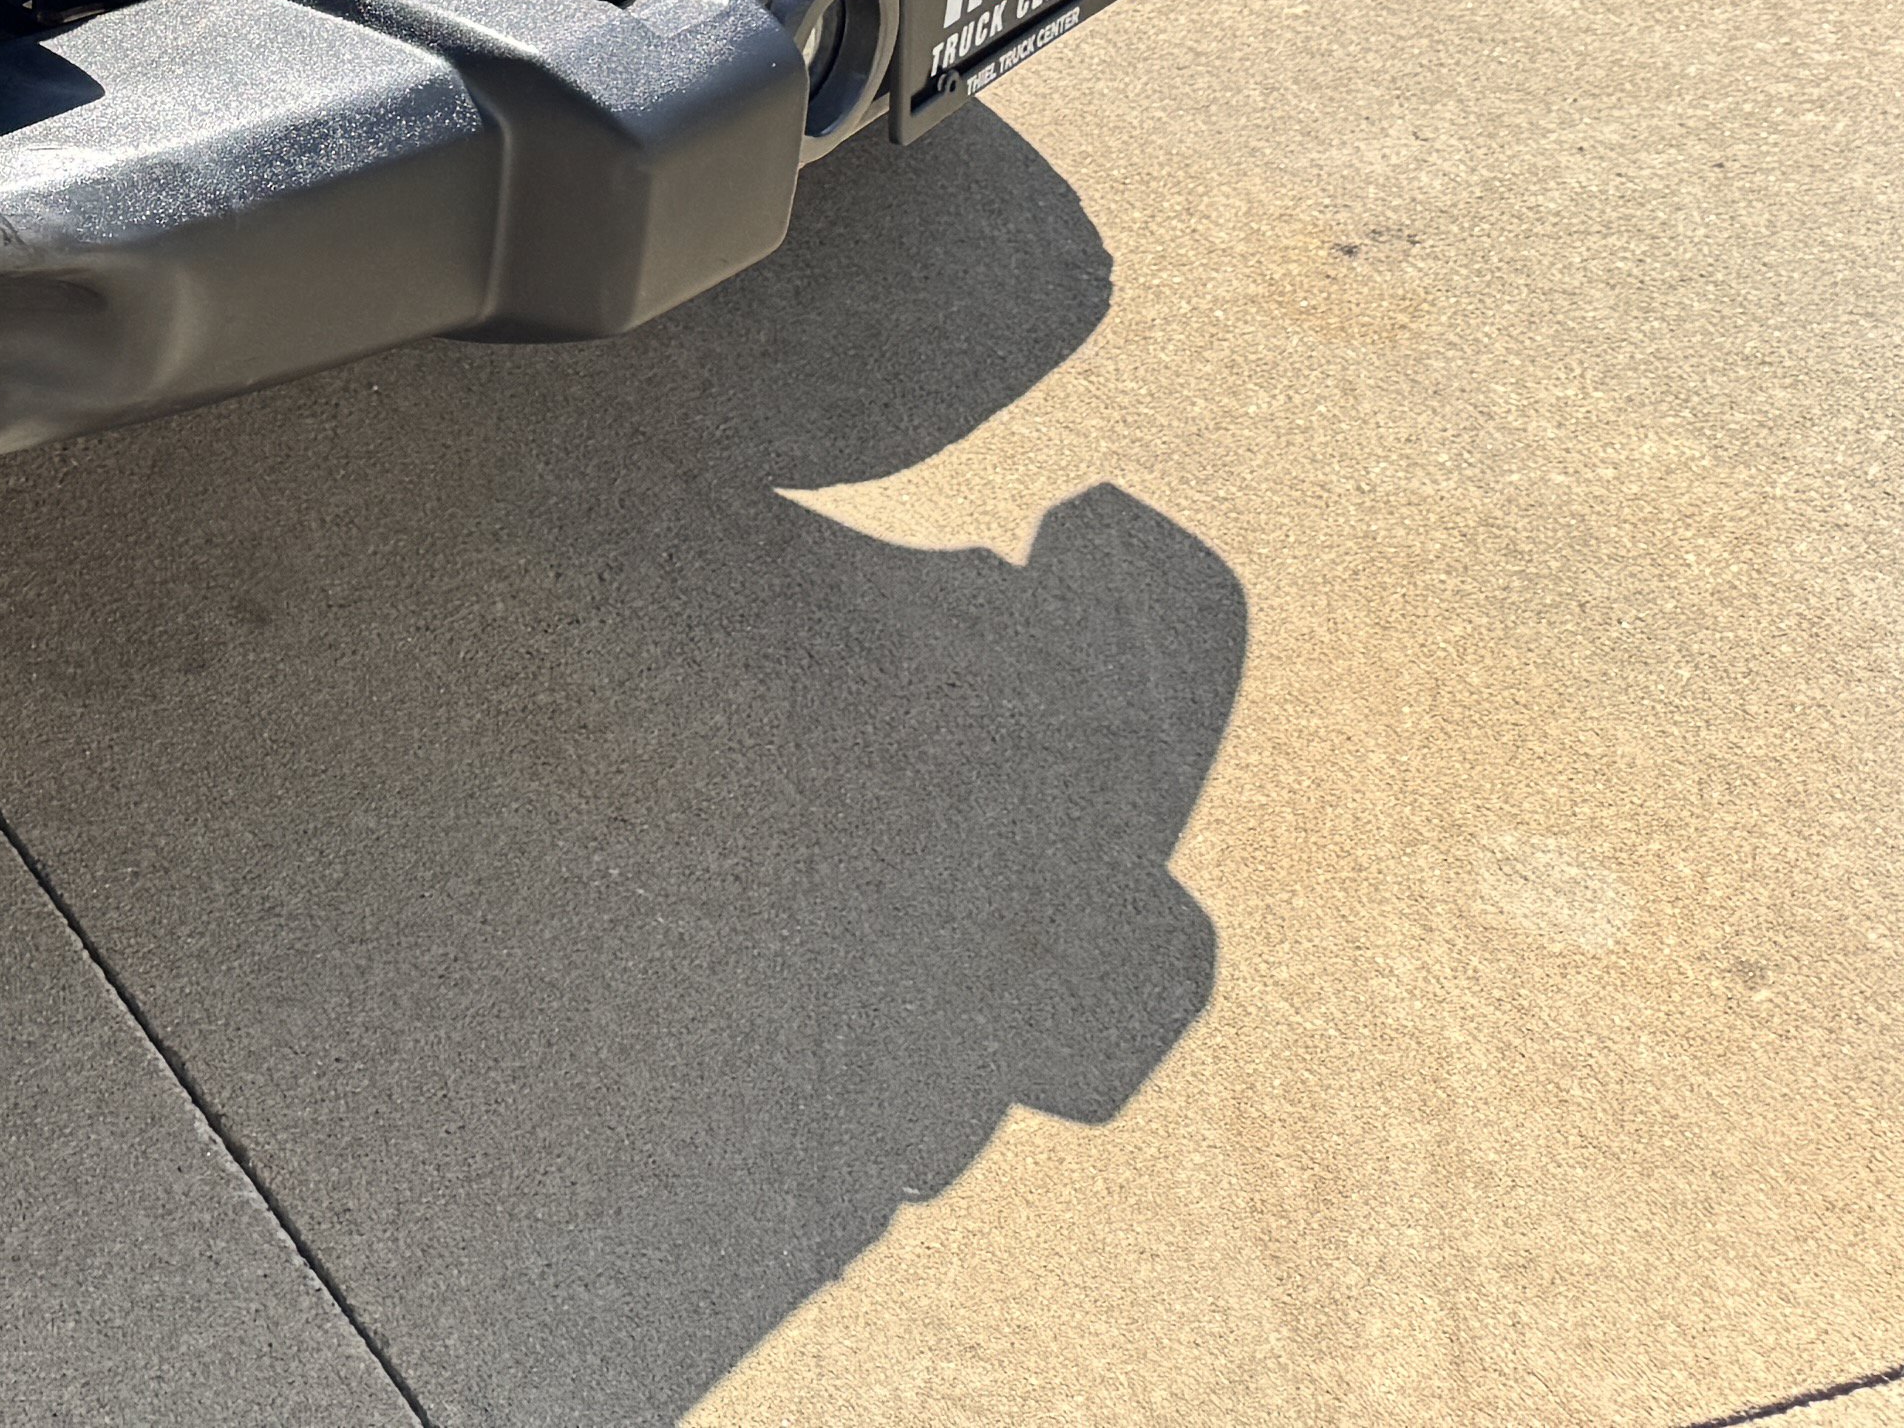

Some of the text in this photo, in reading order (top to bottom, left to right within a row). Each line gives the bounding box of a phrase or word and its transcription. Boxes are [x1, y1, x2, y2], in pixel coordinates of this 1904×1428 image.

[930, 0, 1008, 78] TRUCK
[967, 6, 1081, 96] THIEL TRUCK CENTER
